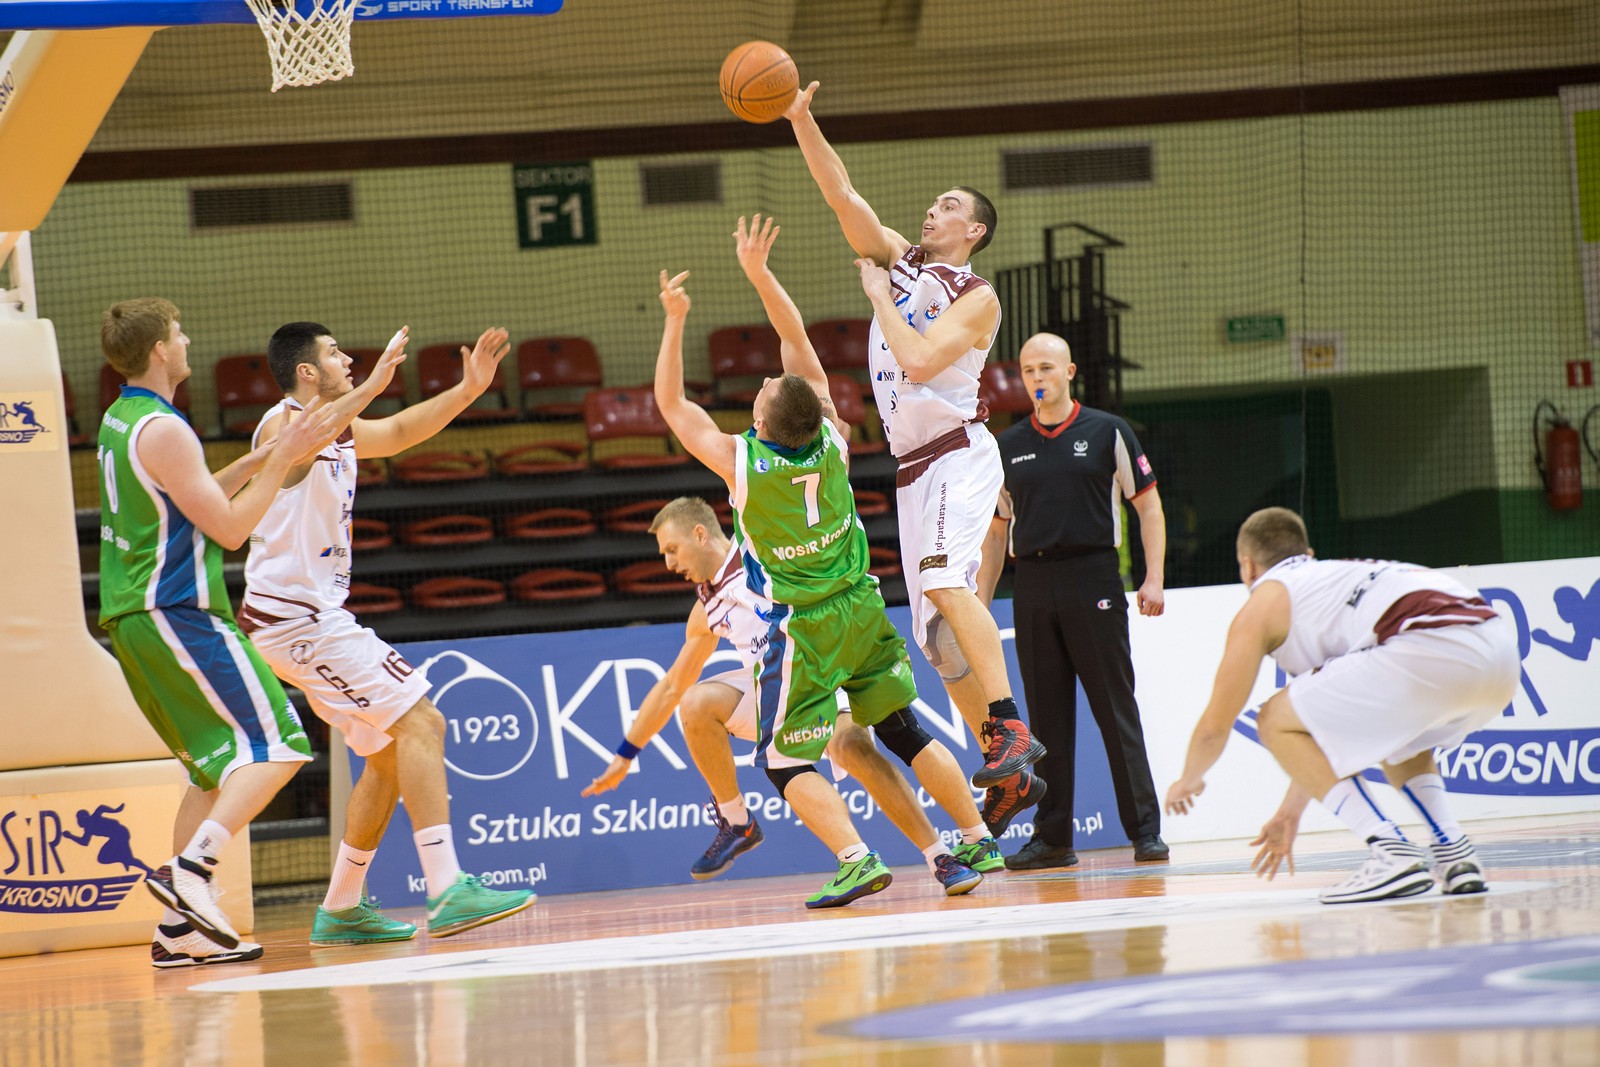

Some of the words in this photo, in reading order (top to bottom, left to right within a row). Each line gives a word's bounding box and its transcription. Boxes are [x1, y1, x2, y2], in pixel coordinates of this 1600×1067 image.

[388, 0, 442, 12] SPORT
[448, 0, 534, 10] TRANSFER
[526, 194, 584, 241] F1
[791, 472, 821, 529] 7
[935, 482, 947, 551] www.stargard.pl
[381, 651, 415, 684] 16
[448, 714, 521, 745] 1923
[783, 724, 834, 745] HEDOM
[1433, 740, 1600, 784] KROSNO
[467, 807, 582, 845] Sztuka
[591, 797, 719, 835] Szklane
[1, 810, 65, 876] SiR
[0, 883, 99, 908] KROSNO
[407, 862, 548, 893] kr.com.pl
